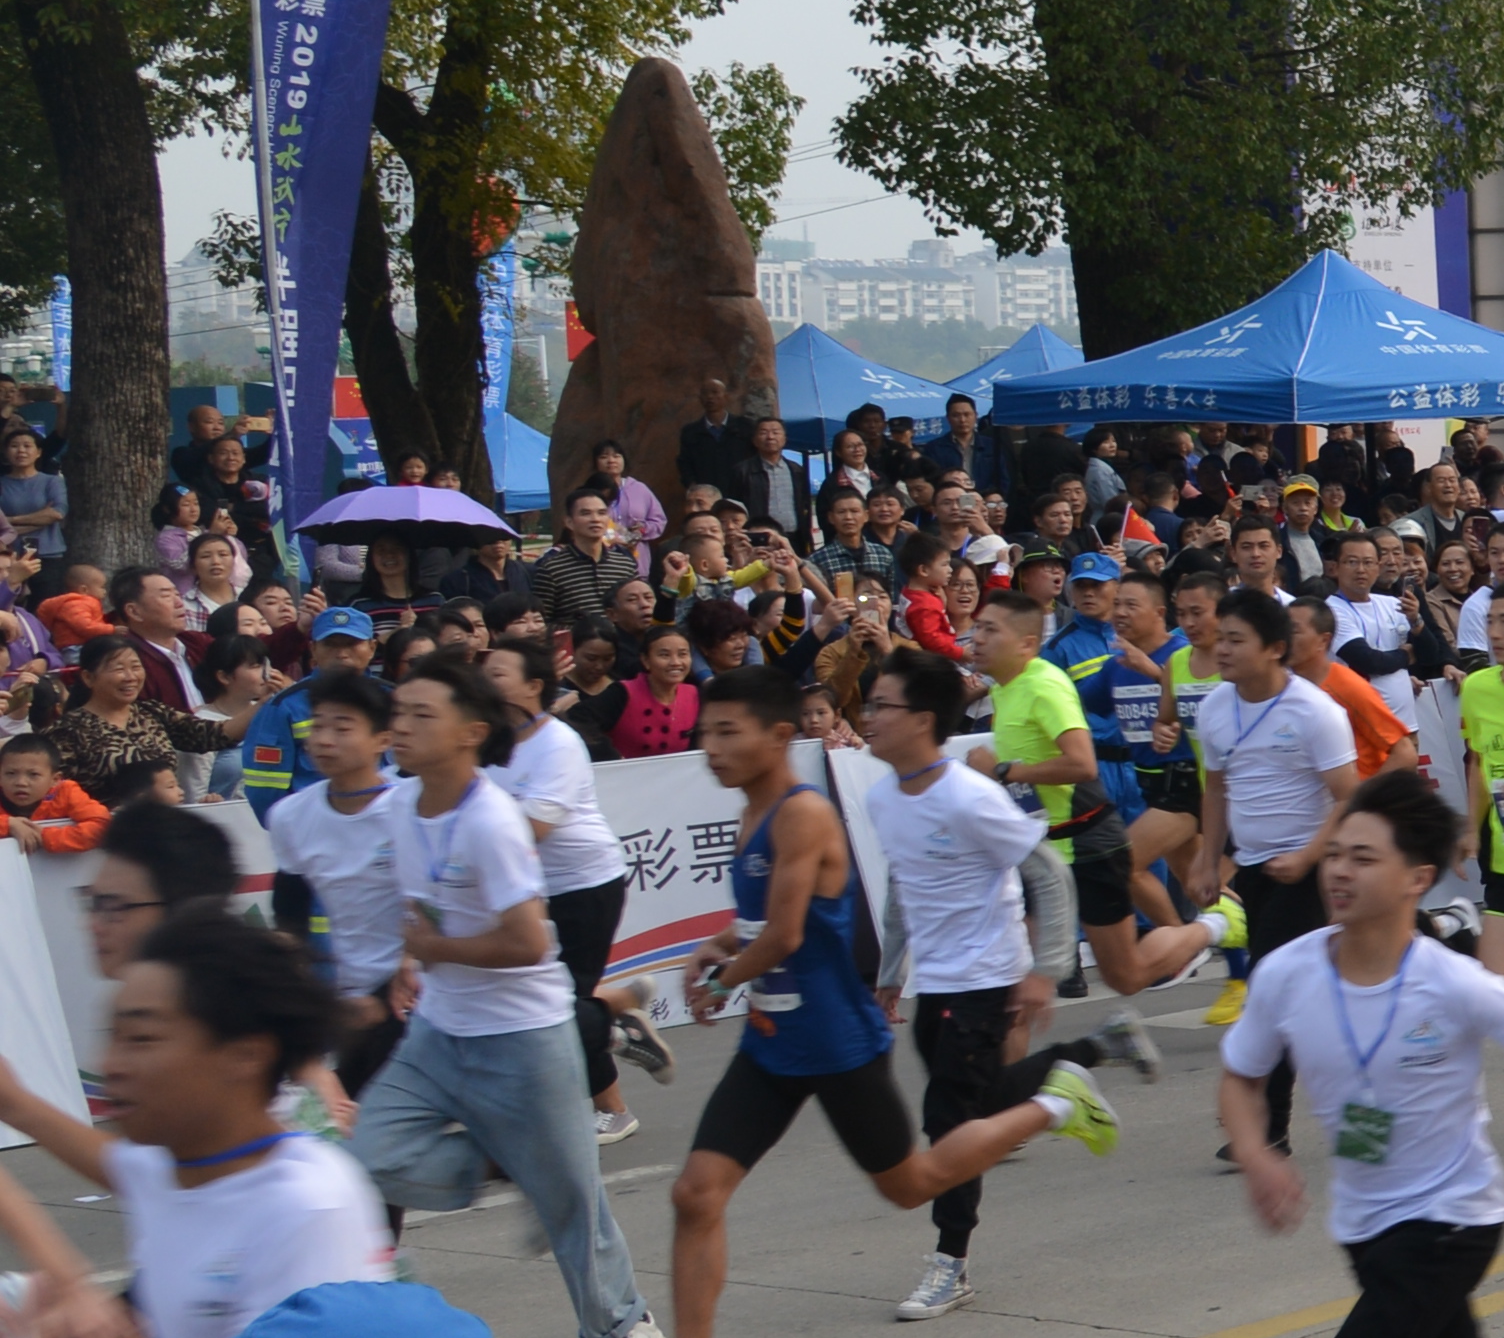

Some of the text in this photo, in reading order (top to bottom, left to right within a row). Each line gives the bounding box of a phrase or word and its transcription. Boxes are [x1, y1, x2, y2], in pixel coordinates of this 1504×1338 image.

[287, 22, 319, 110] 2019
[1057, 385, 1132, 411] 公益体彩
[1143, 383, 1218, 411] 乐善人生
[1387, 382, 1481, 411] 公益体彩
[618, 818, 741, 893] 彩票
